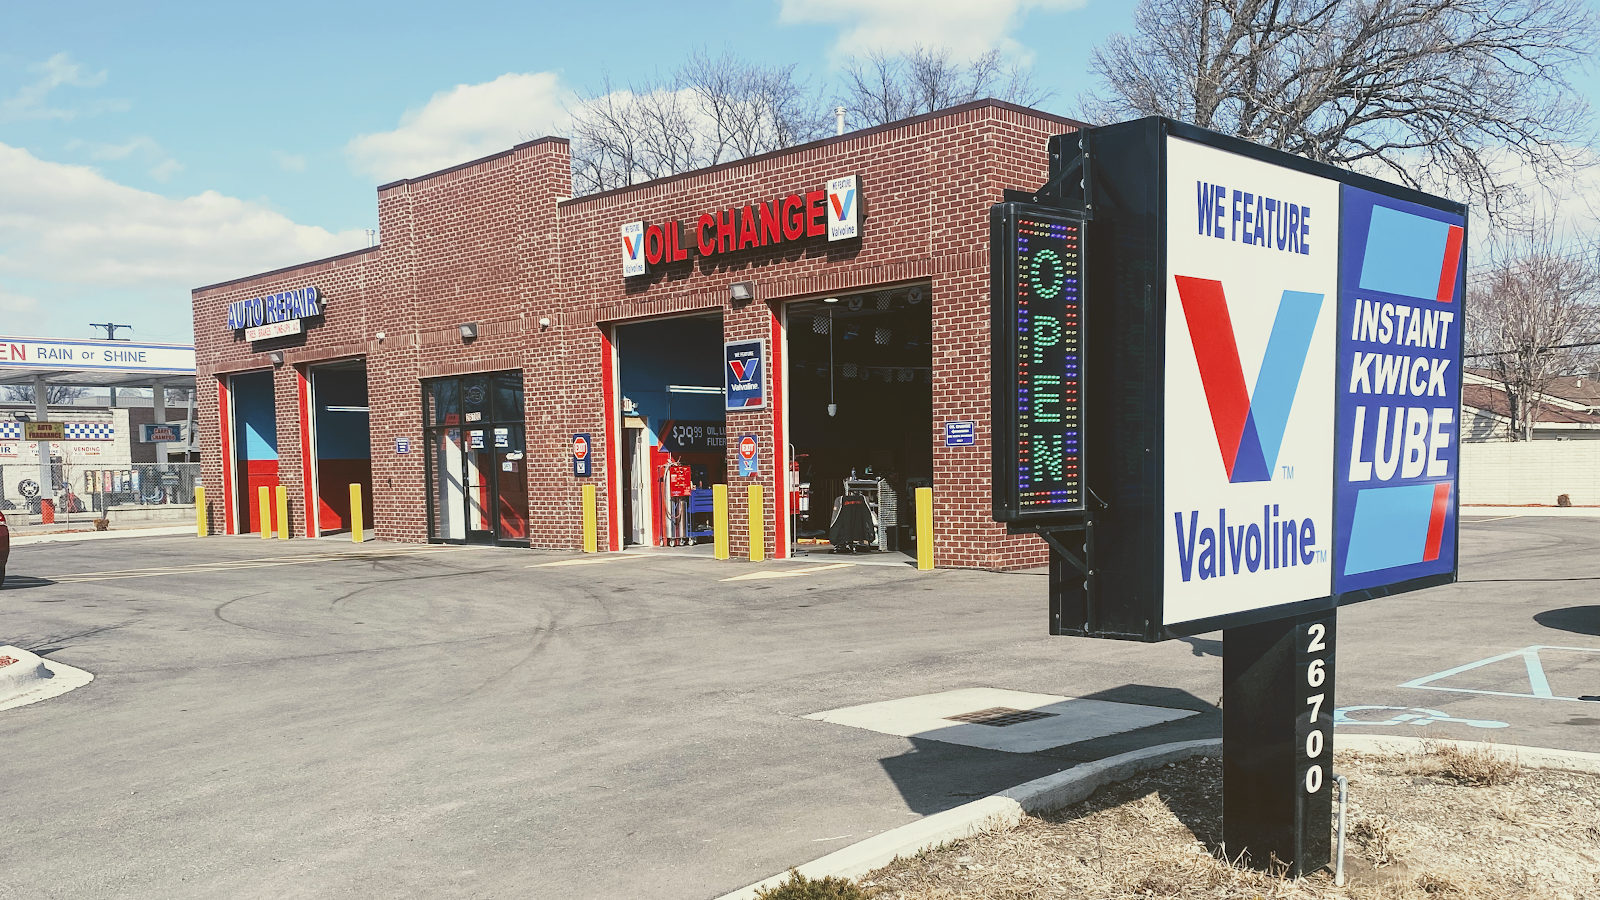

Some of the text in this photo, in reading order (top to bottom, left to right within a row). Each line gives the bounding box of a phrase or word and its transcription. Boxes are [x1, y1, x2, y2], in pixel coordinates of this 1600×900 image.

[645, 190, 826, 265] OIL CHANGE
[1196, 180, 1311, 256] WE FEATURE
[227, 287, 320, 330] AUTO REPAIR
[1351, 298, 1454, 350] INSTANT
[37, 347, 73, 361] RAIN
[81, 350, 95, 360] or
[103, 350, 147, 363] SHINE
[1030, 248, 1064, 482] OPEN
[1349, 351, 1451, 397] KWICK
[1348, 406, 1454, 482] LUBE
[1174, 503, 1316, 583] Valvoline
[1305, 623, 1326, 794] 26700
